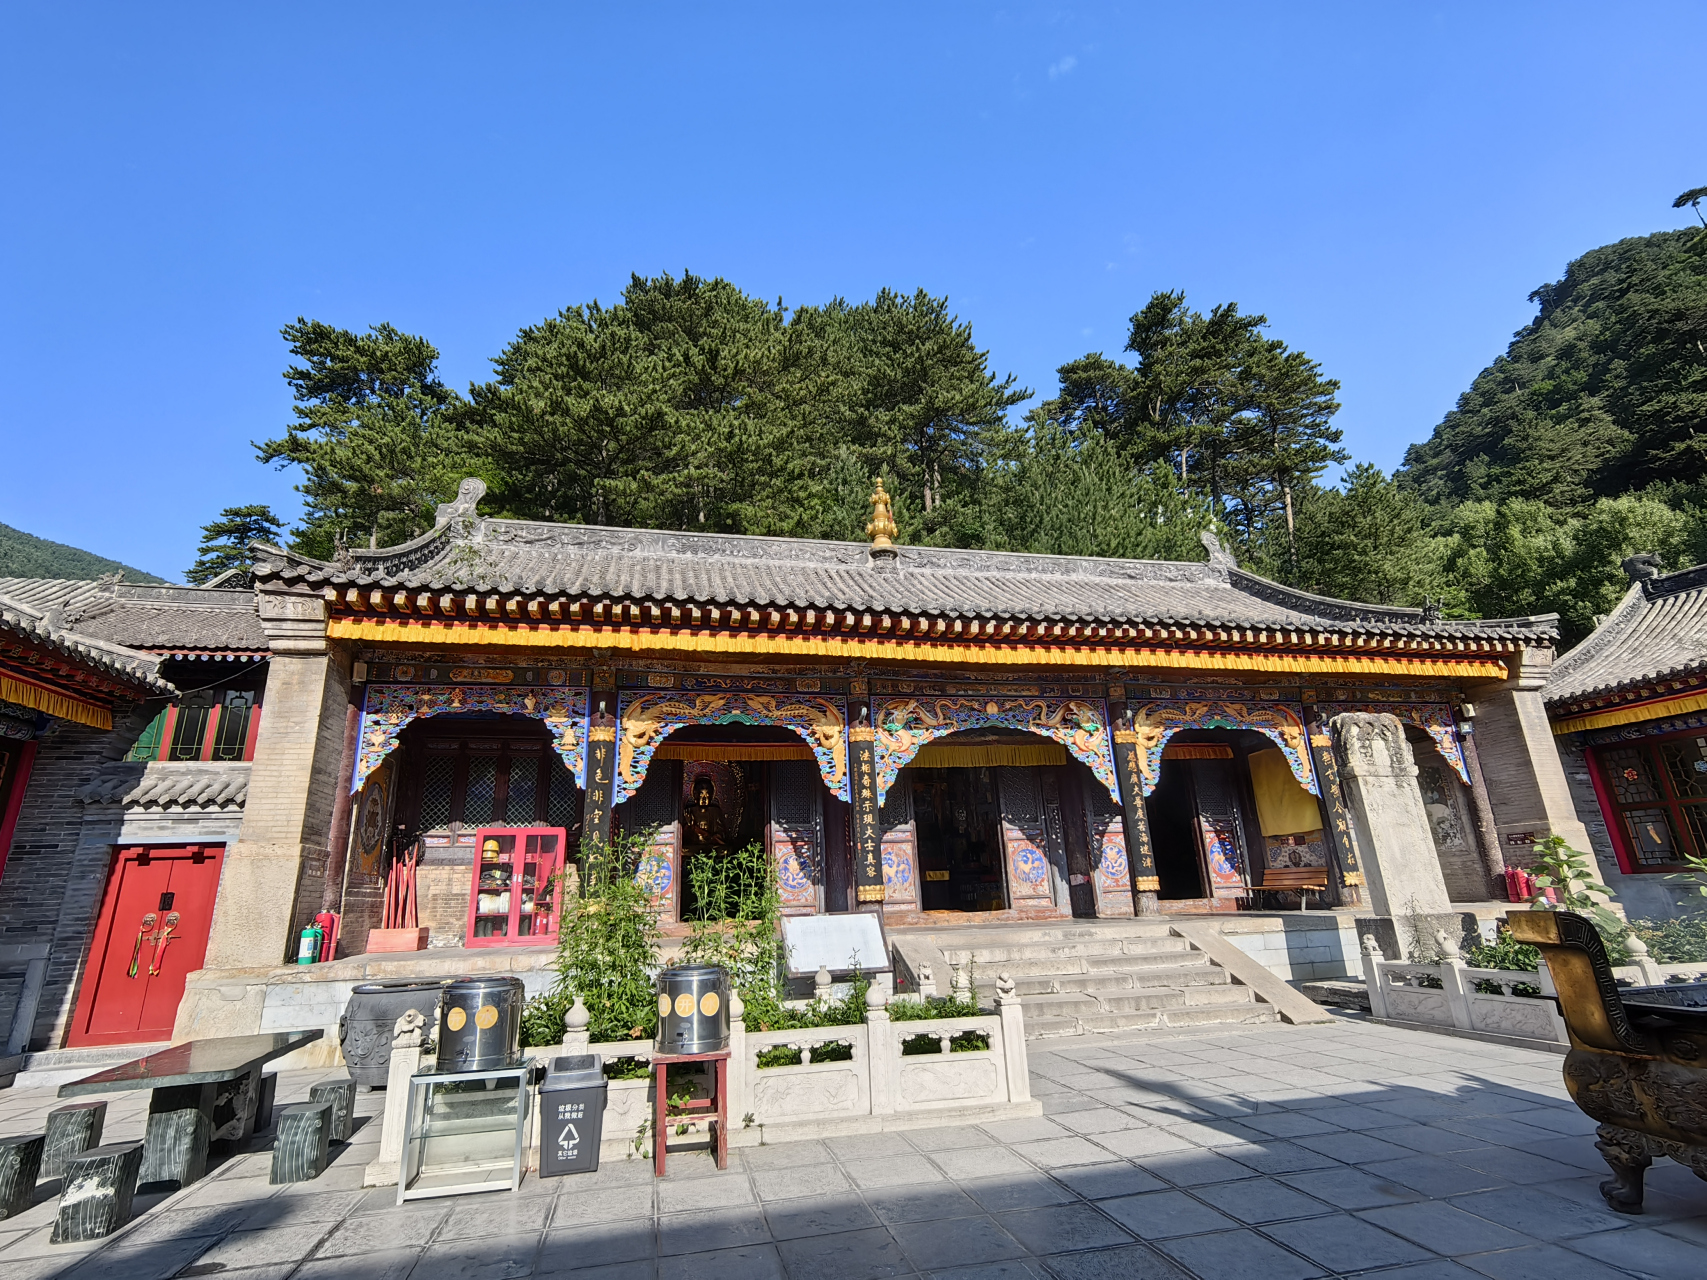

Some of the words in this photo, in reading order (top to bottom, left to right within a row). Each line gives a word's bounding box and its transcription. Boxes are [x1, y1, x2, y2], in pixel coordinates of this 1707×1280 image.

[558, 1103, 585, 1112] 垃圾分类
[557, 1111, 584, 1120] 从我做起
